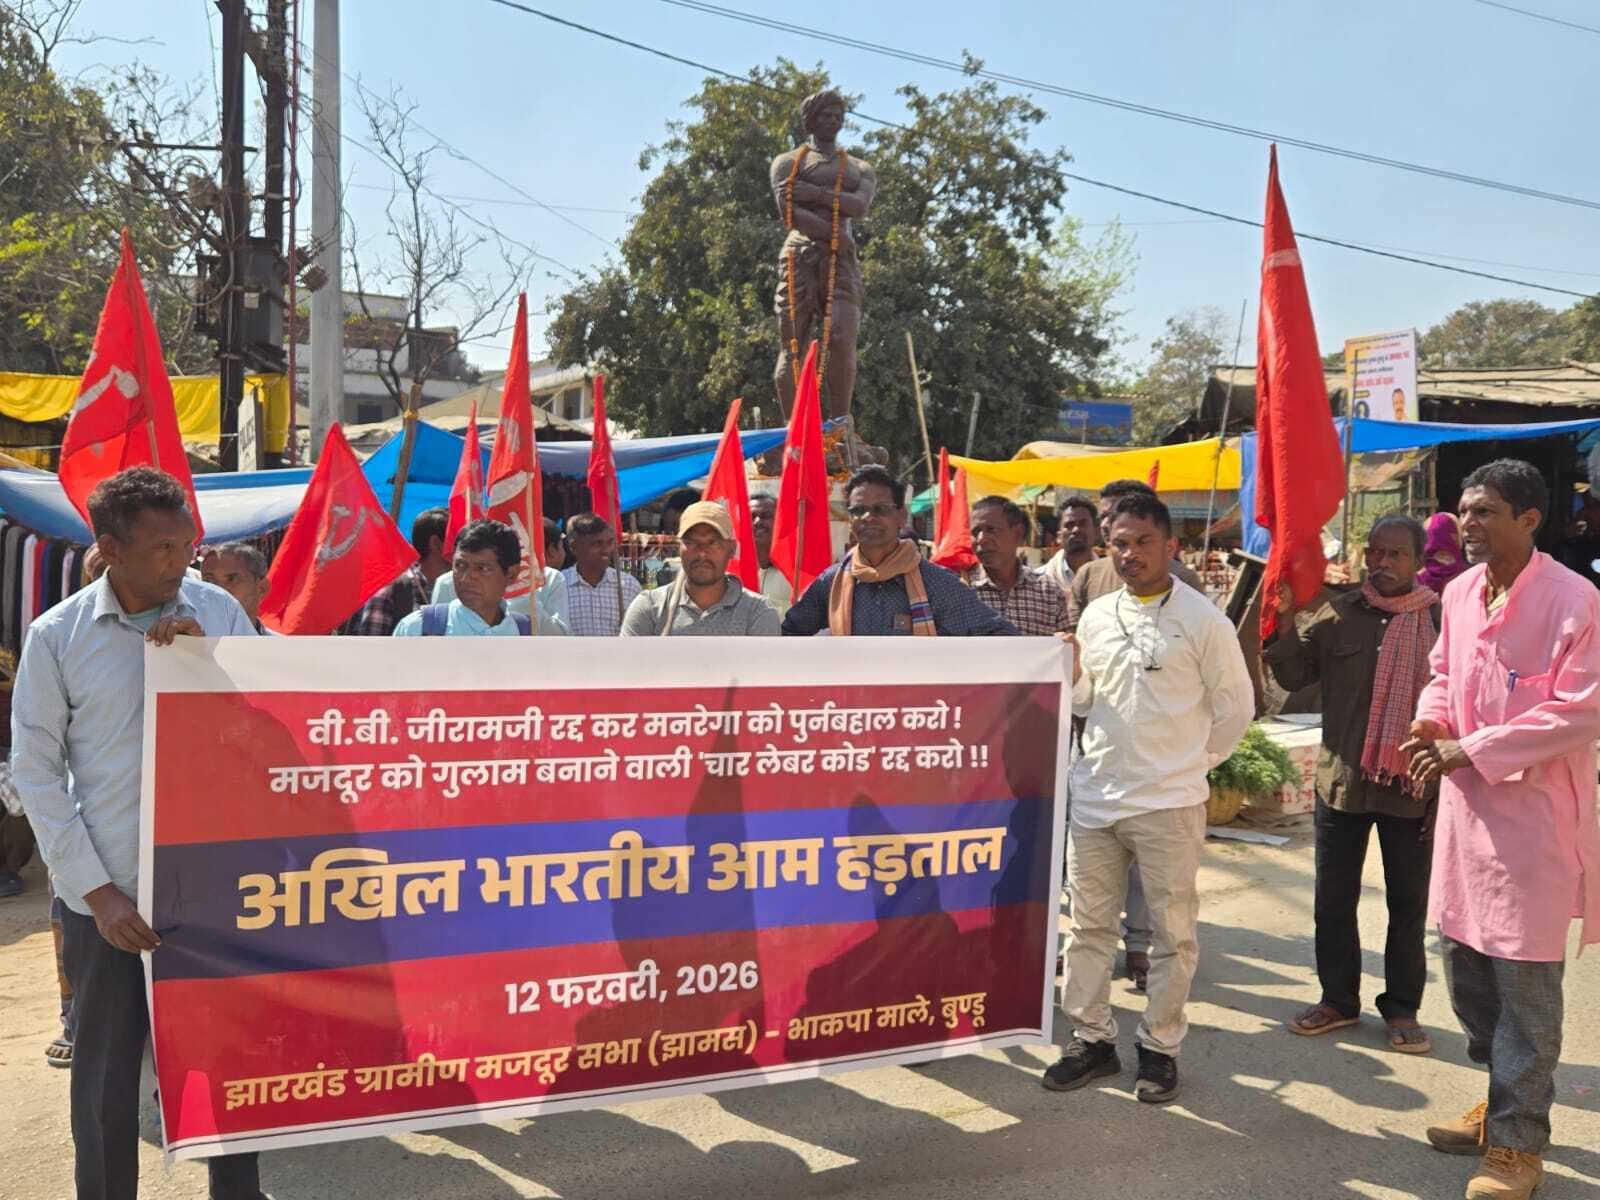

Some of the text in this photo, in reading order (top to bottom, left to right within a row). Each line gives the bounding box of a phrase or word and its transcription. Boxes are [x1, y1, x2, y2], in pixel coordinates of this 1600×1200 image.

[306, 708, 399, 746] वी.बी.
[405, 705, 545, 743] जीरामजी
[549, 714, 587, 743] रद्द
[590, 712, 639, 739] कर
[643, 703, 743, 737] मनरेगा
[746, 702, 785, 735] को
[788, 702, 898, 744] पुर्नबहाल
[901, 699, 950, 730] करो
[268, 764, 375, 804] मजदूर
[379, 754, 426, 790] को
[431, 757, 530, 799] गुलाम
[534, 748, 620, 783] बनाने
[624, 746, 693, 781] वाली
[755, 742, 817, 775] लेबर
[880, 746, 912, 773] रद्द
[914, 738, 965, 769] करो
[236, 826, 1007, 930] अखिल भारतीय आम हड़ताल
[504, 959, 759, 1015] 12 फरवरी, 2026
[223, 1063, 349, 1111] झारखंड
[354, 1052, 470, 1093] ग्रामीण
[475, 1046, 573, 1085] मजदूर
[577, 1038, 643, 1067] सभा
[648, 1020, 759, 1067] (झामस)
[787, 1008, 873, 1041] भाकपा
[875, 994, 935, 1027] माले,
[940, 990, 988, 1030] बुण्डू
